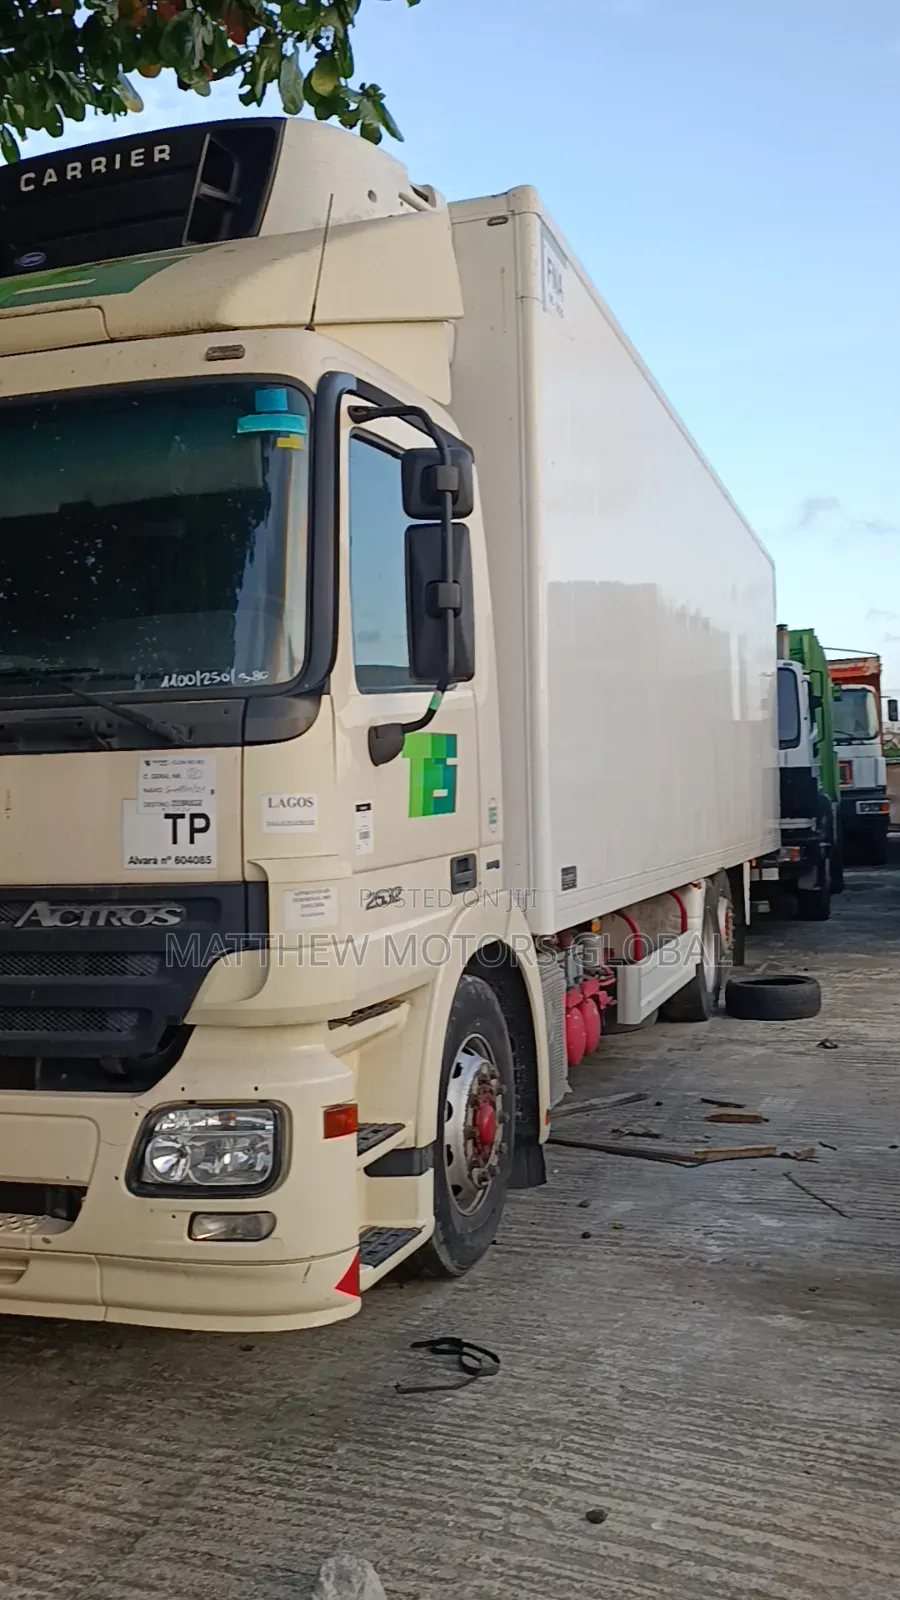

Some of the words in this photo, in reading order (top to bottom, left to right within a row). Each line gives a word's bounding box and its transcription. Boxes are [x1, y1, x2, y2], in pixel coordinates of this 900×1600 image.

[20, 144, 171, 192] CARRIER
[267, 796, 315, 809] LAGOS
[163, 813, 211, 845] TP
[173, 855, 213, 865] 604085
[14, 900, 184, 928] ACTROS
